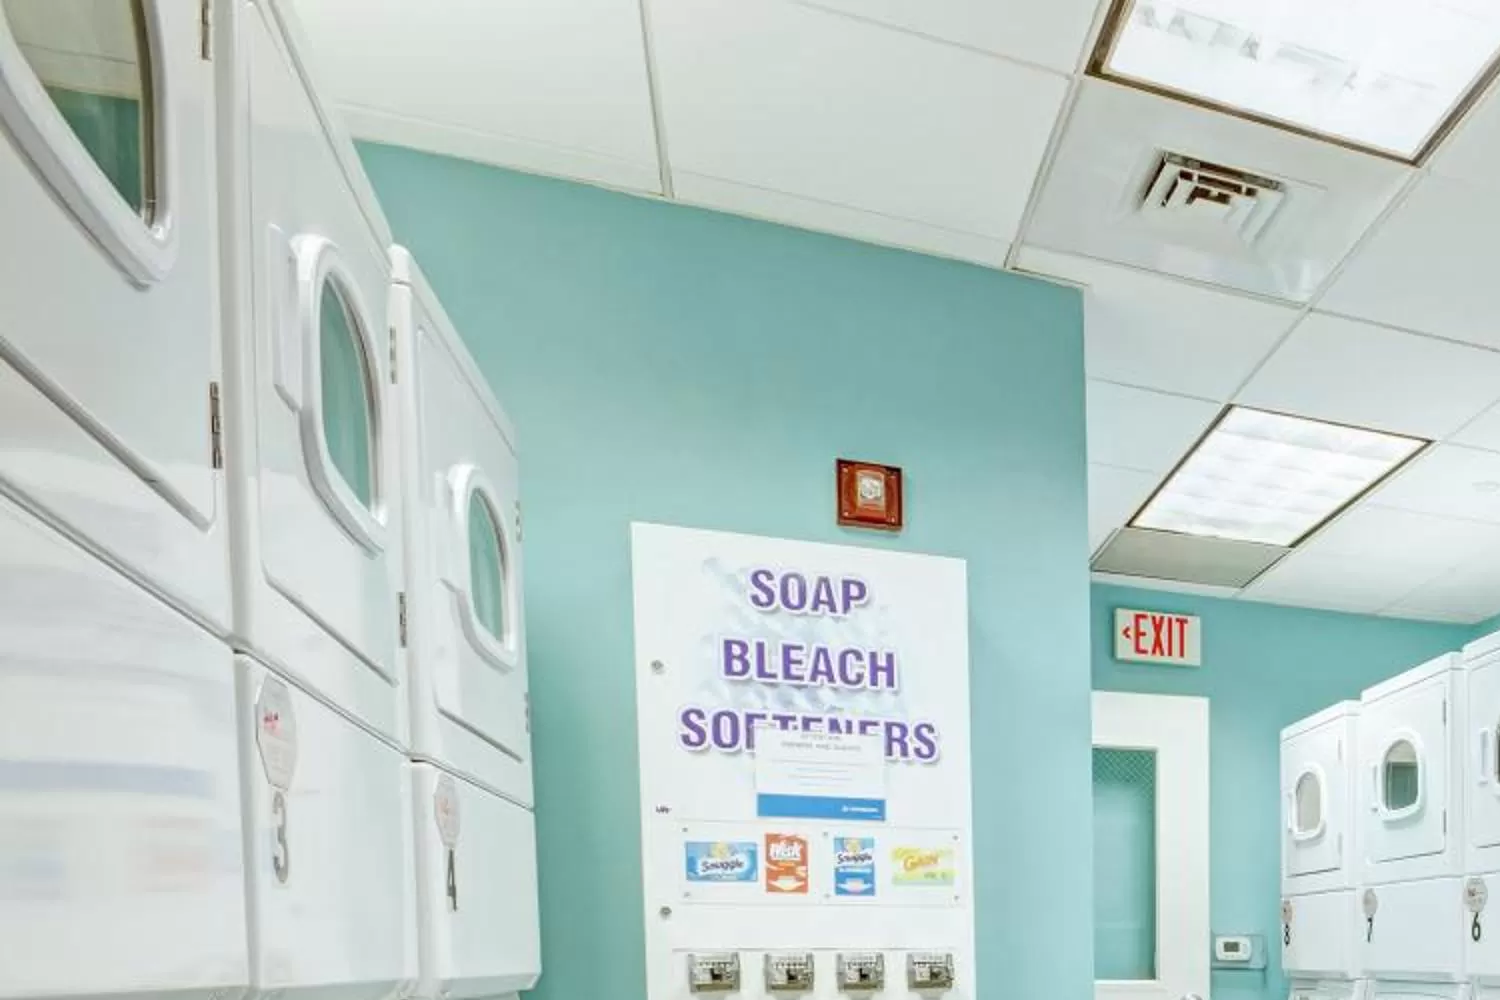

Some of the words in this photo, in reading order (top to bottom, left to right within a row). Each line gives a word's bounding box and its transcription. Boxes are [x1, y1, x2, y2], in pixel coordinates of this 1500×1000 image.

[750, 569, 868, 616] SOAP
[1134, 613, 1189, 659] EXIT
[722, 638, 896, 690] BLEACH
[273, 791, 289, 884] 3
[1283, 923, 1291, 947] 8
[1366, 916, 1374, 943] 7
[1471, 911, 1482, 942] 6
